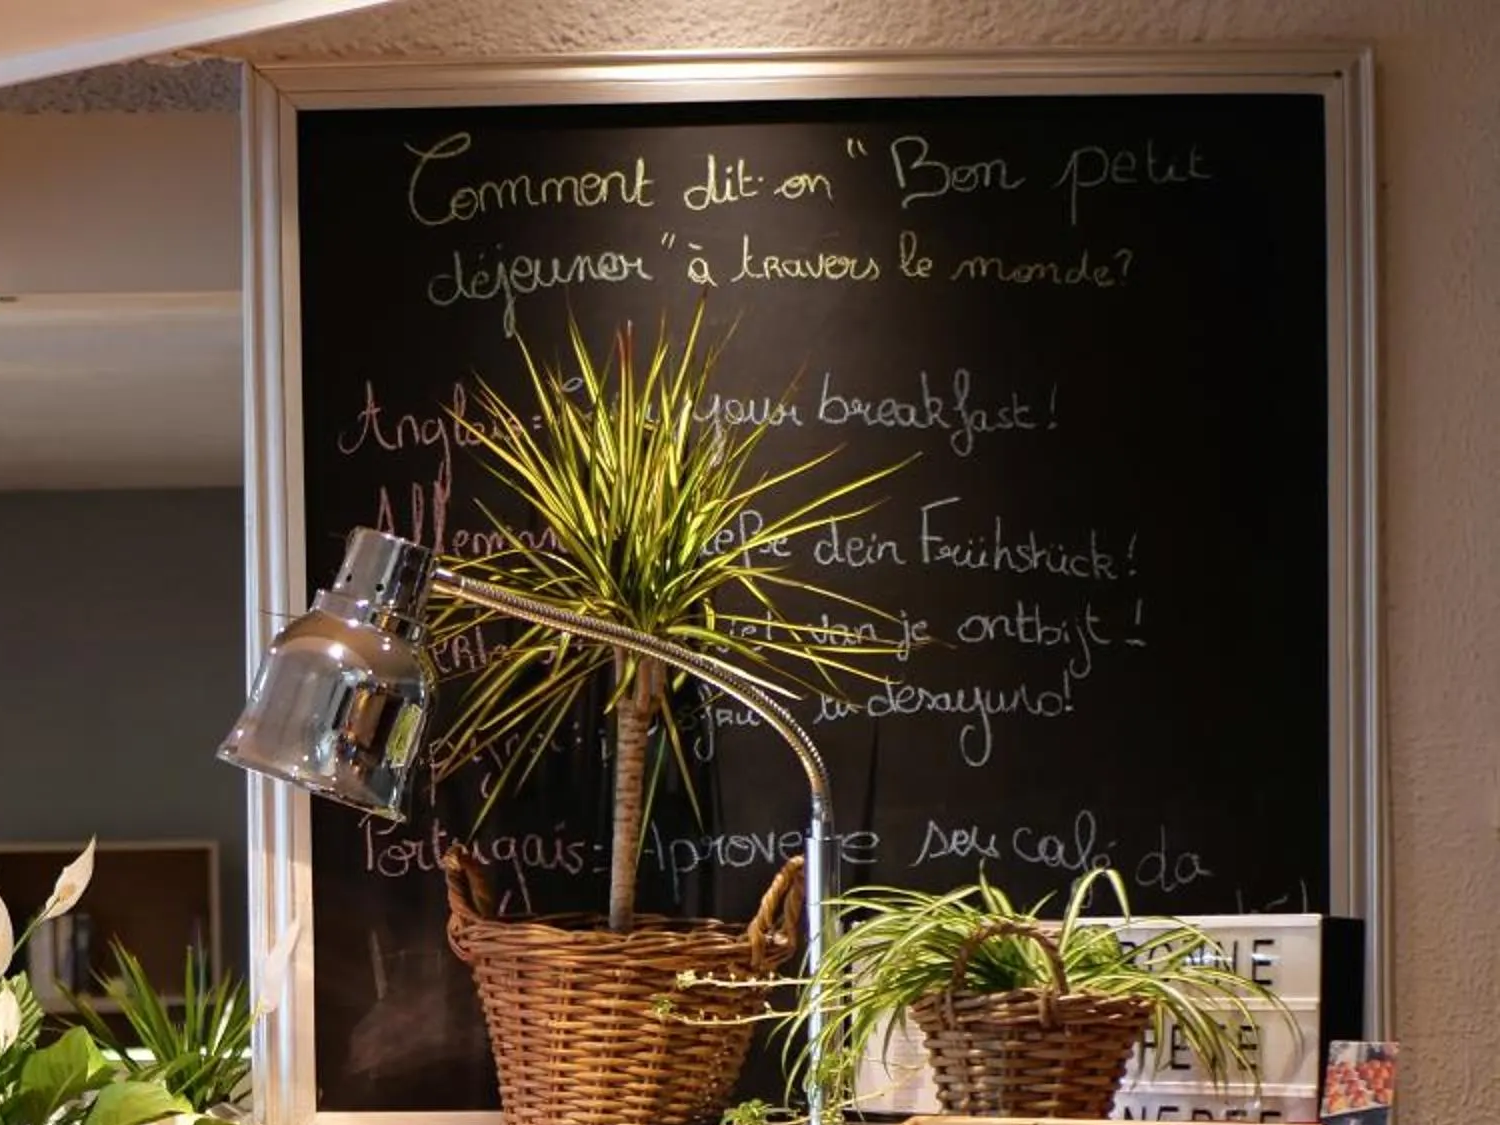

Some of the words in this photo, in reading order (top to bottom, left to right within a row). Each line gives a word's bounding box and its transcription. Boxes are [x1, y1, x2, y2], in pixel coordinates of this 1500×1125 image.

[404, 132, 654, 225] Comment
[1051, 137, 1214, 226] petit
[686, 241, 719, 288] à
[729, 233, 881, 282] travers
[899, 230, 934, 279] le
[949, 247, 1136, 287] monde?
[812, 516, 907, 567] dein
